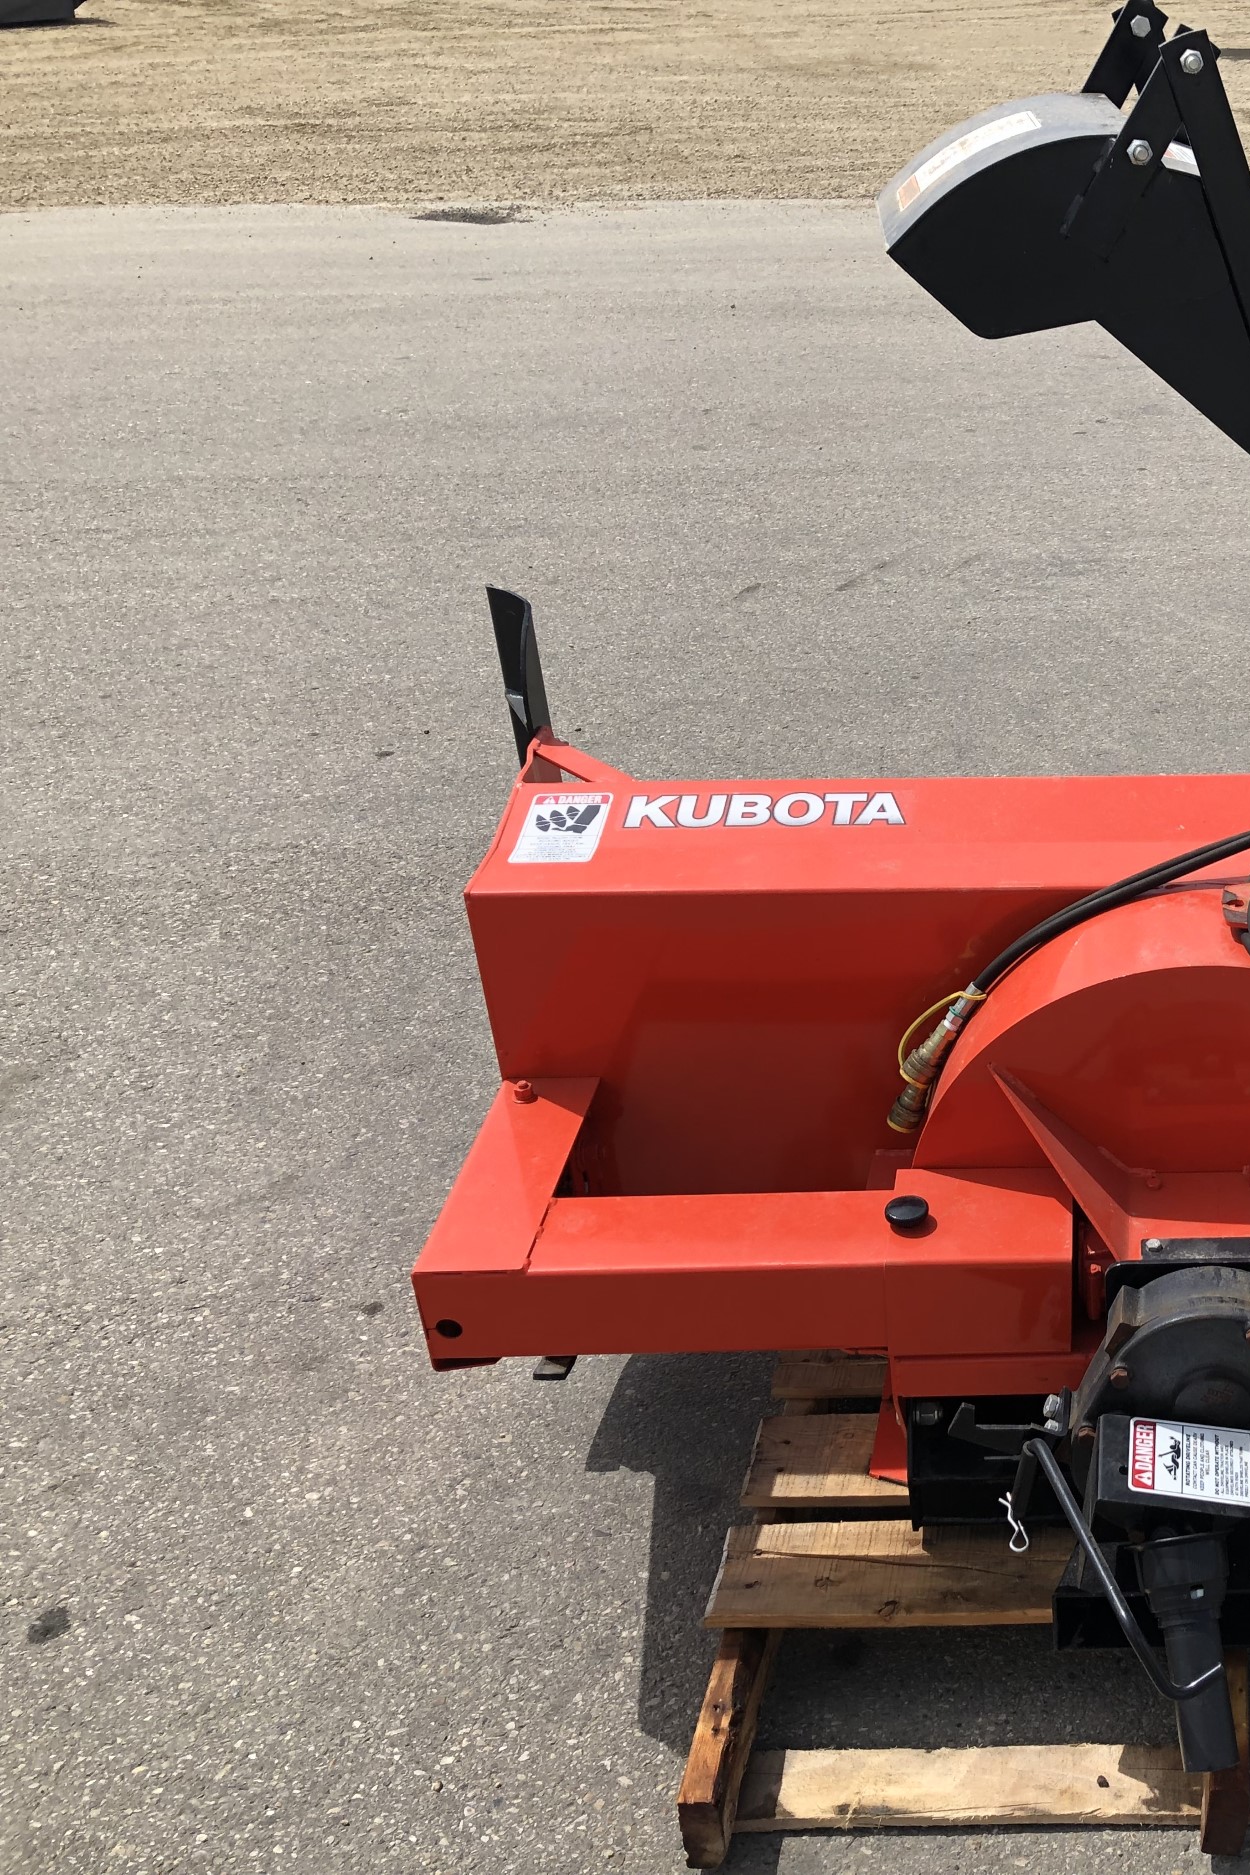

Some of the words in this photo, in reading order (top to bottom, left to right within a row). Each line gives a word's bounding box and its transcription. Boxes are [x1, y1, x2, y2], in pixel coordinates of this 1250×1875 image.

[557, 795, 603, 804] DANGER
[623, 792, 907, 828] KUBOTA
[1135, 1425, 1154, 1471] DANGER
